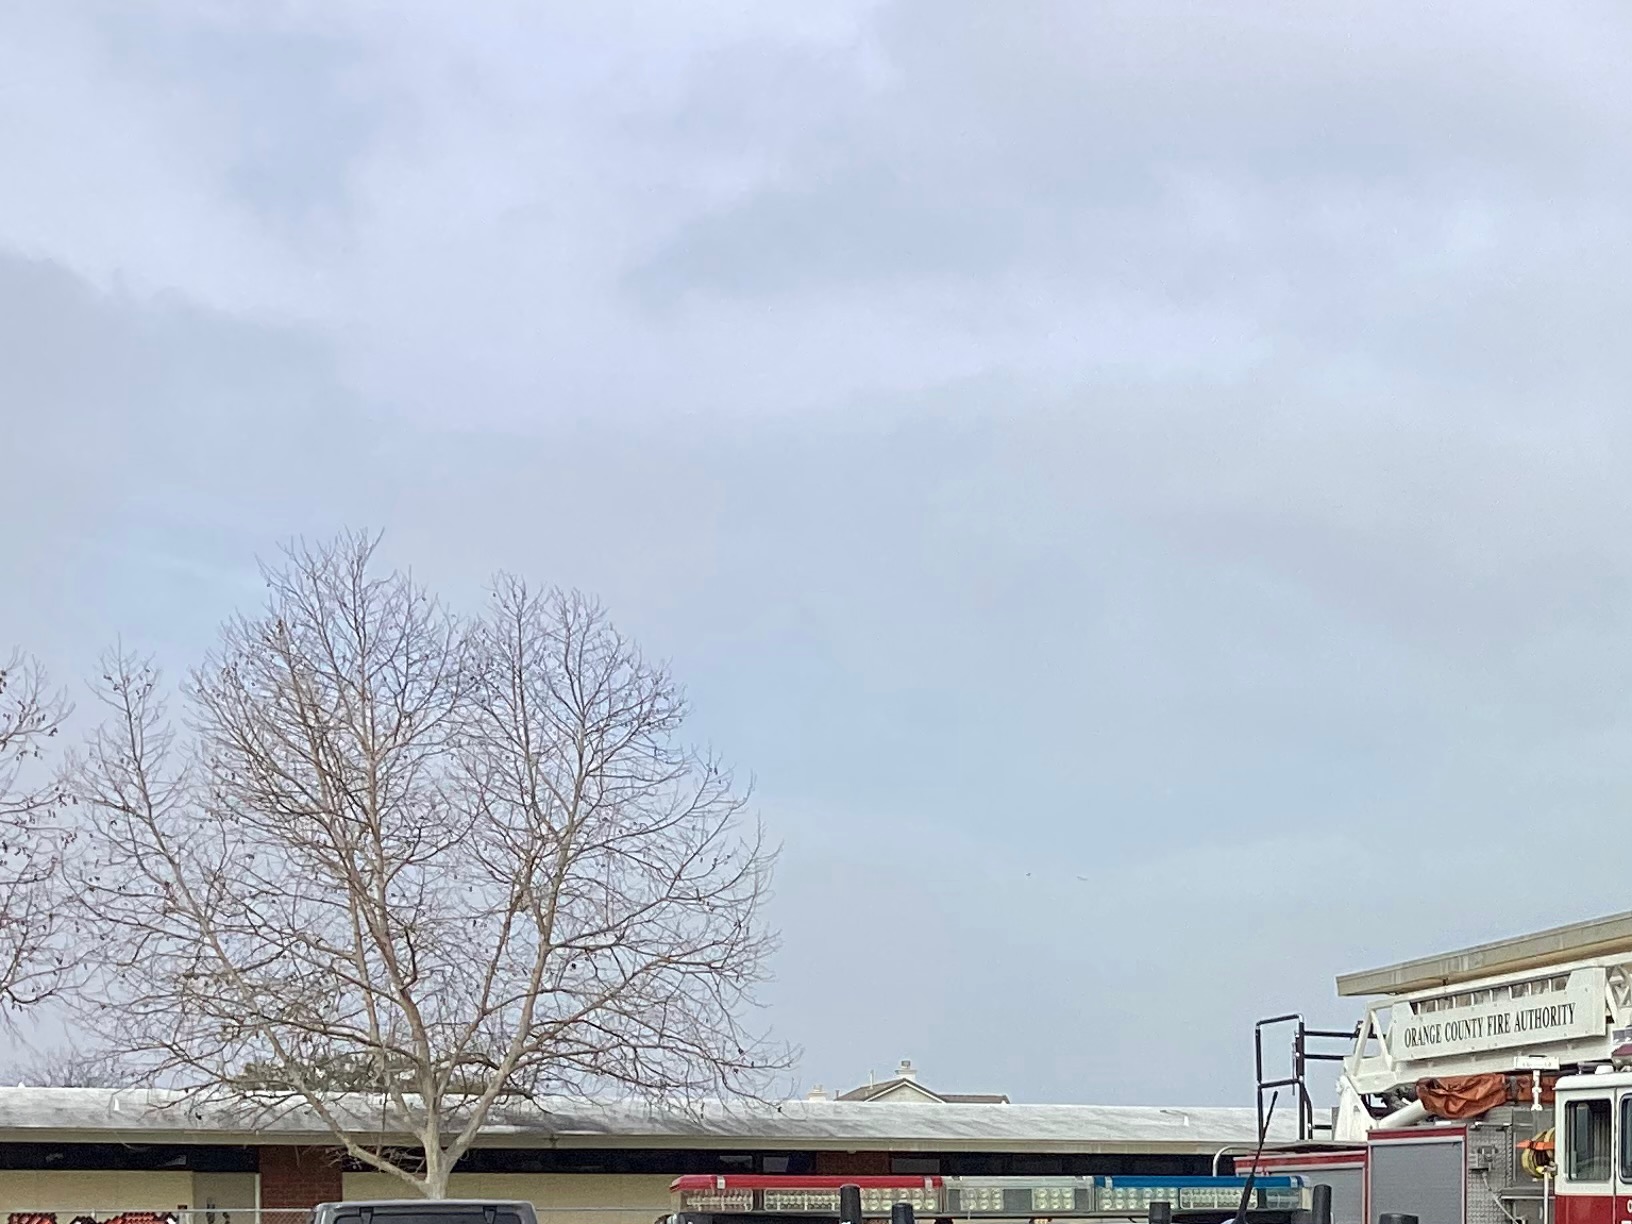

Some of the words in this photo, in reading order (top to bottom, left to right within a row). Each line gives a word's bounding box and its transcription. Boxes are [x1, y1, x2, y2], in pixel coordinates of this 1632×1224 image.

[1404, 1023, 1442, 1048] ORANGE
[1444, 1017, 1484, 1043] COUNTY
[1487, 1012, 1511, 1036] FIRE
[1514, 1002, 1576, 1033] AUTHORITY
